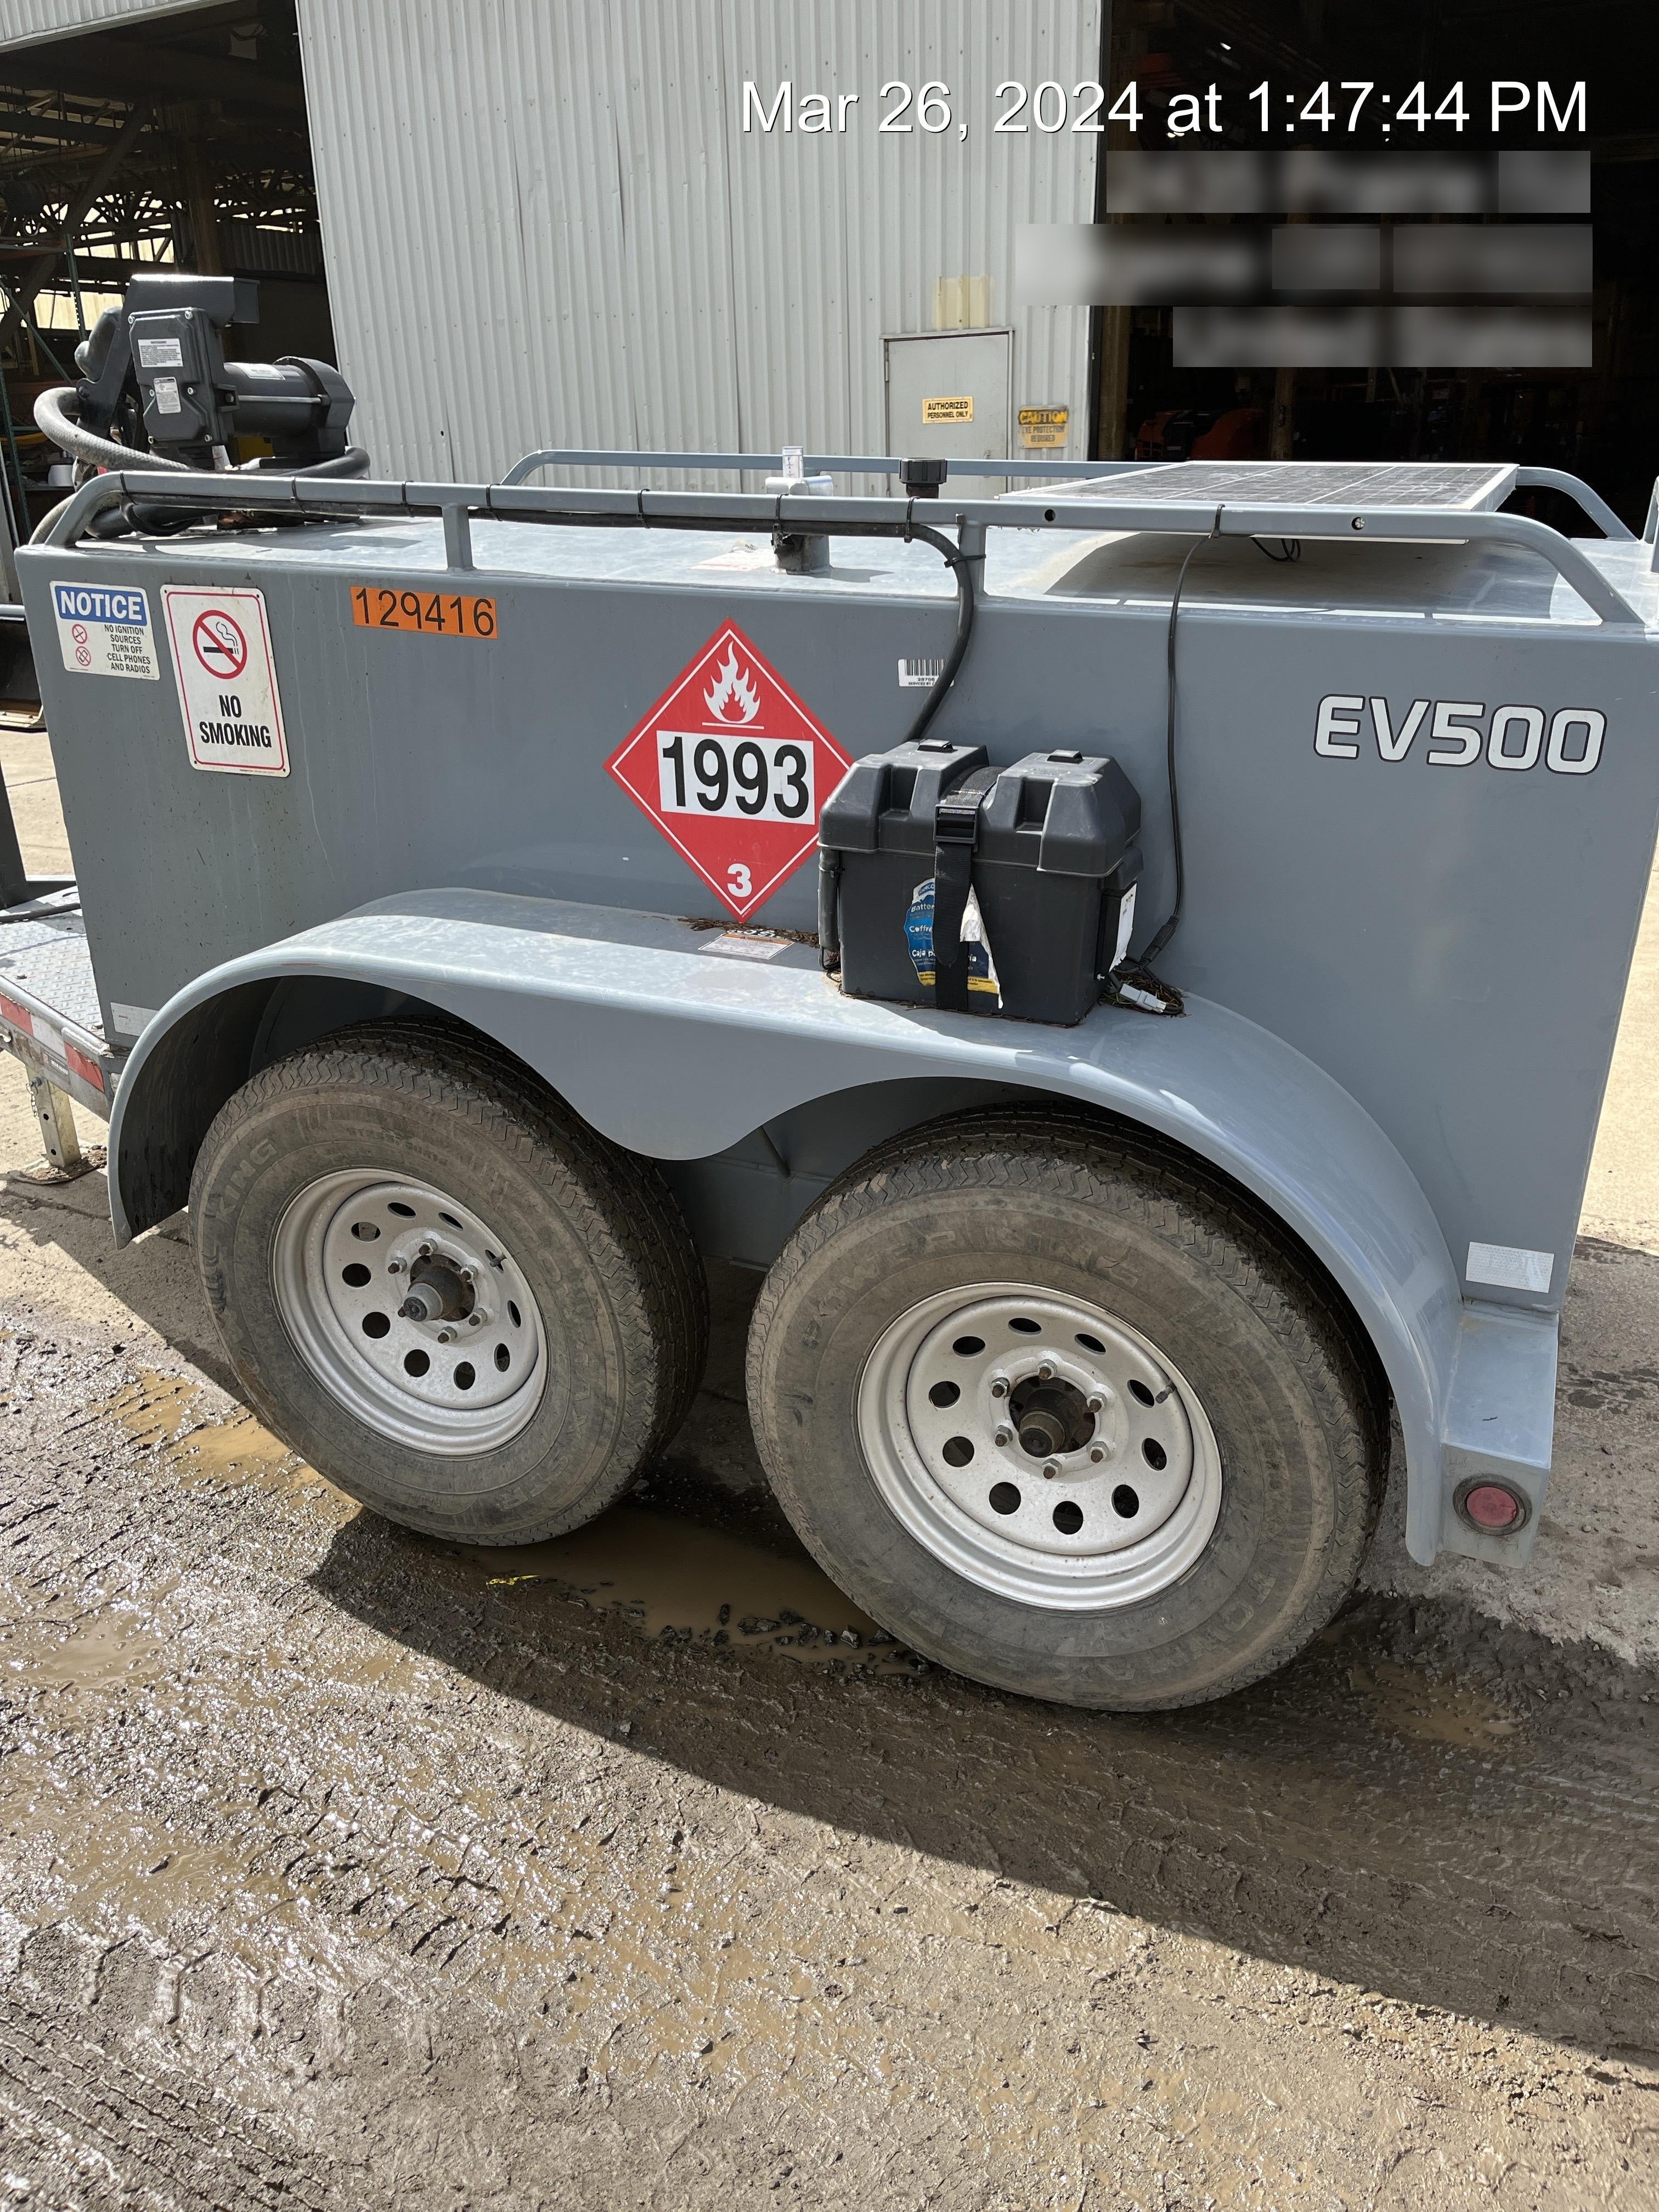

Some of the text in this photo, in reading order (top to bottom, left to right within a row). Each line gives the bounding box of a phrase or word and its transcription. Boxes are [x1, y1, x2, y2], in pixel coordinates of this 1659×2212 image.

[927, 401, 968, 410] AUTHORIZED
[1019, 411, 1068, 424] CAUTION
[60, 590, 143, 620] NOTICE
[356, 588, 494, 636] 129416
[104, 624, 144, 635] NO IGNITION
[110, 634, 141, 645] SOURCES
[108, 653, 151, 664] CELL PHONES
[111, 644, 143, 654] TURN OFF
[111, 663, 150, 674] AND RADIOS
[219, 695, 242, 718] NO
[199, 721, 272, 748] SMOKING
[1313, 693, 1608, 776] EV500
[662, 736, 809, 819] 1993
[726, 863, 752, 898] 3
[216, 1138, 278, 1223] KING
